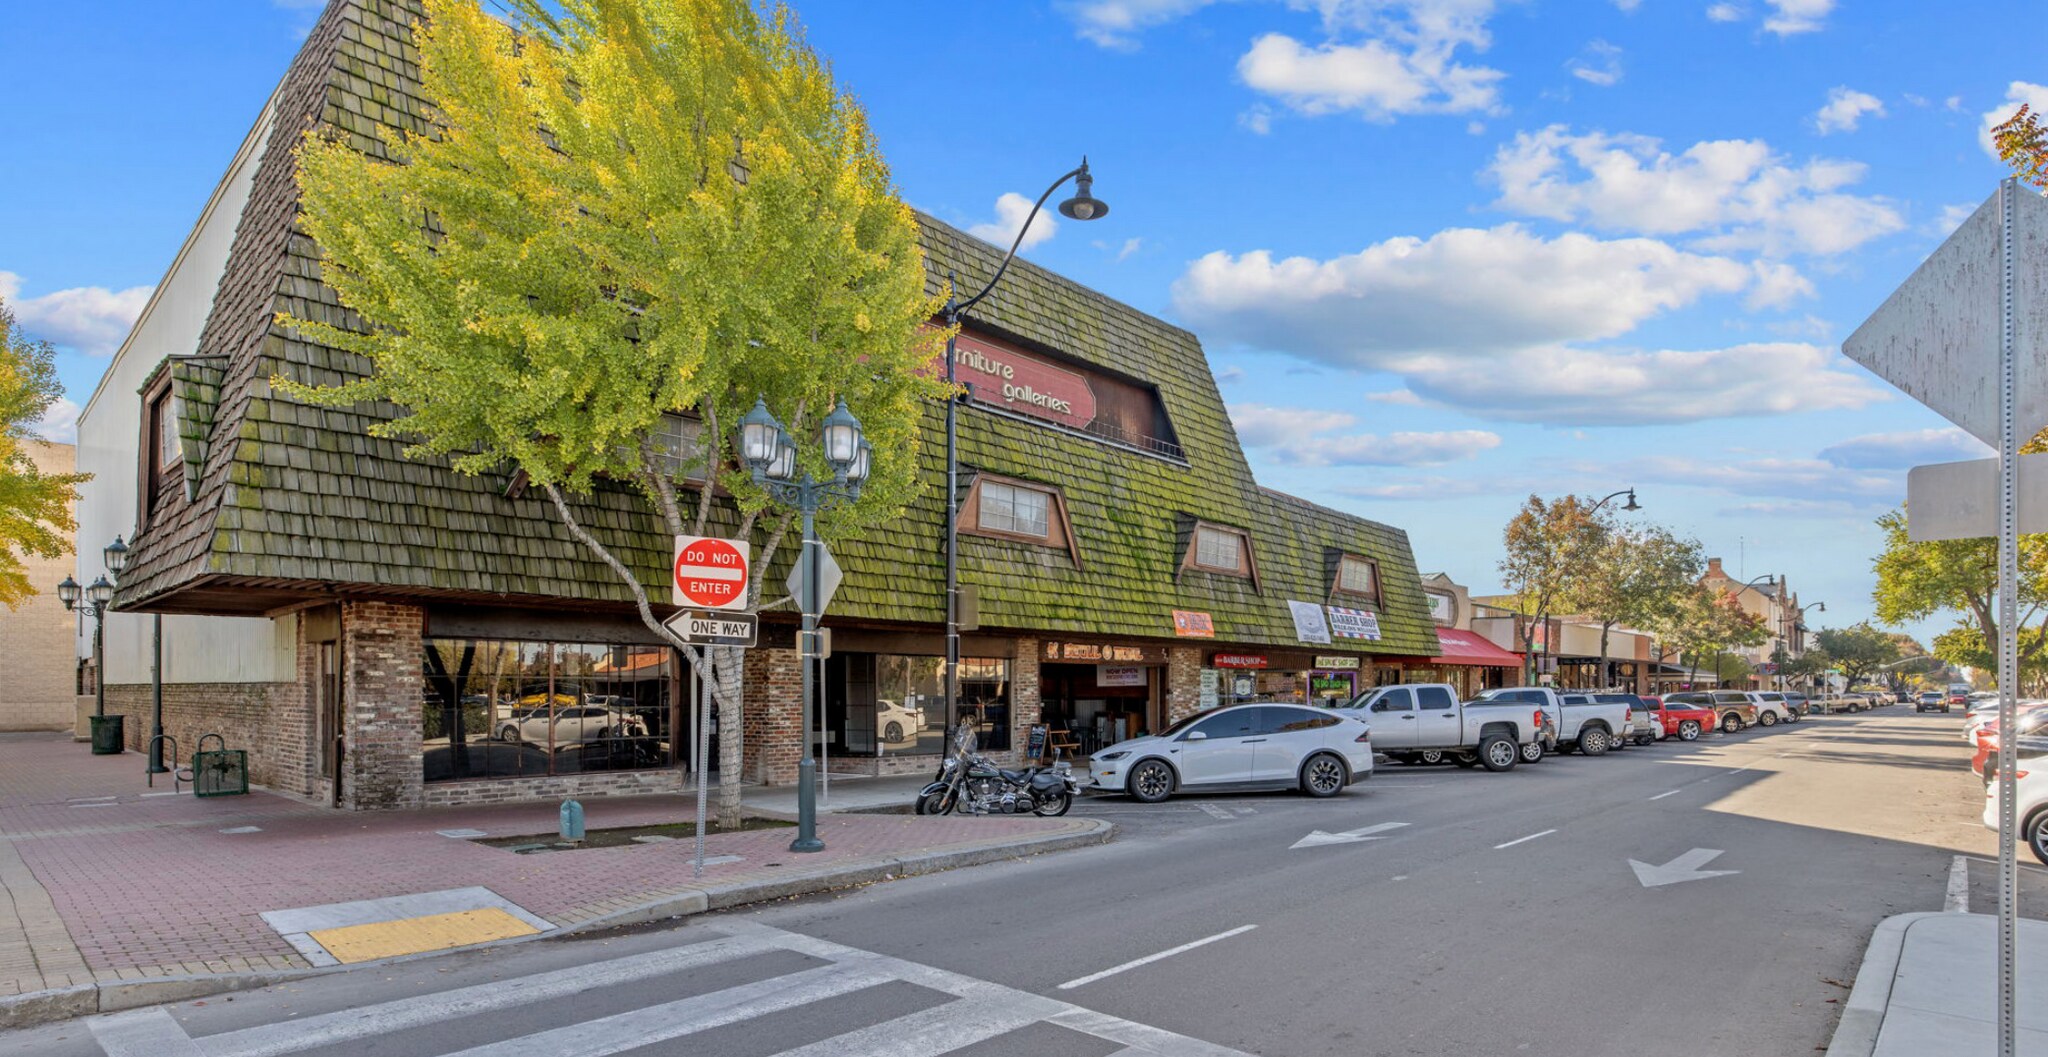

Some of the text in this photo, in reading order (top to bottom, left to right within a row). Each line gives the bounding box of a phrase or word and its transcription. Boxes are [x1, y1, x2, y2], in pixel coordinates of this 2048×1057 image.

[944, 348, 1014, 379] rniture
[1003, 383, 1072, 415] galleries
[687, 551, 737, 565] DO NOT
[690, 582, 731, 595] ENTER
[691, 621, 748, 635] ONE WAY
[1331, 614, 1376, 628] BARBER SHOP
[1223, 656, 1246, 666] BARBER
[1246, 657, 1261, 665] SHOP
